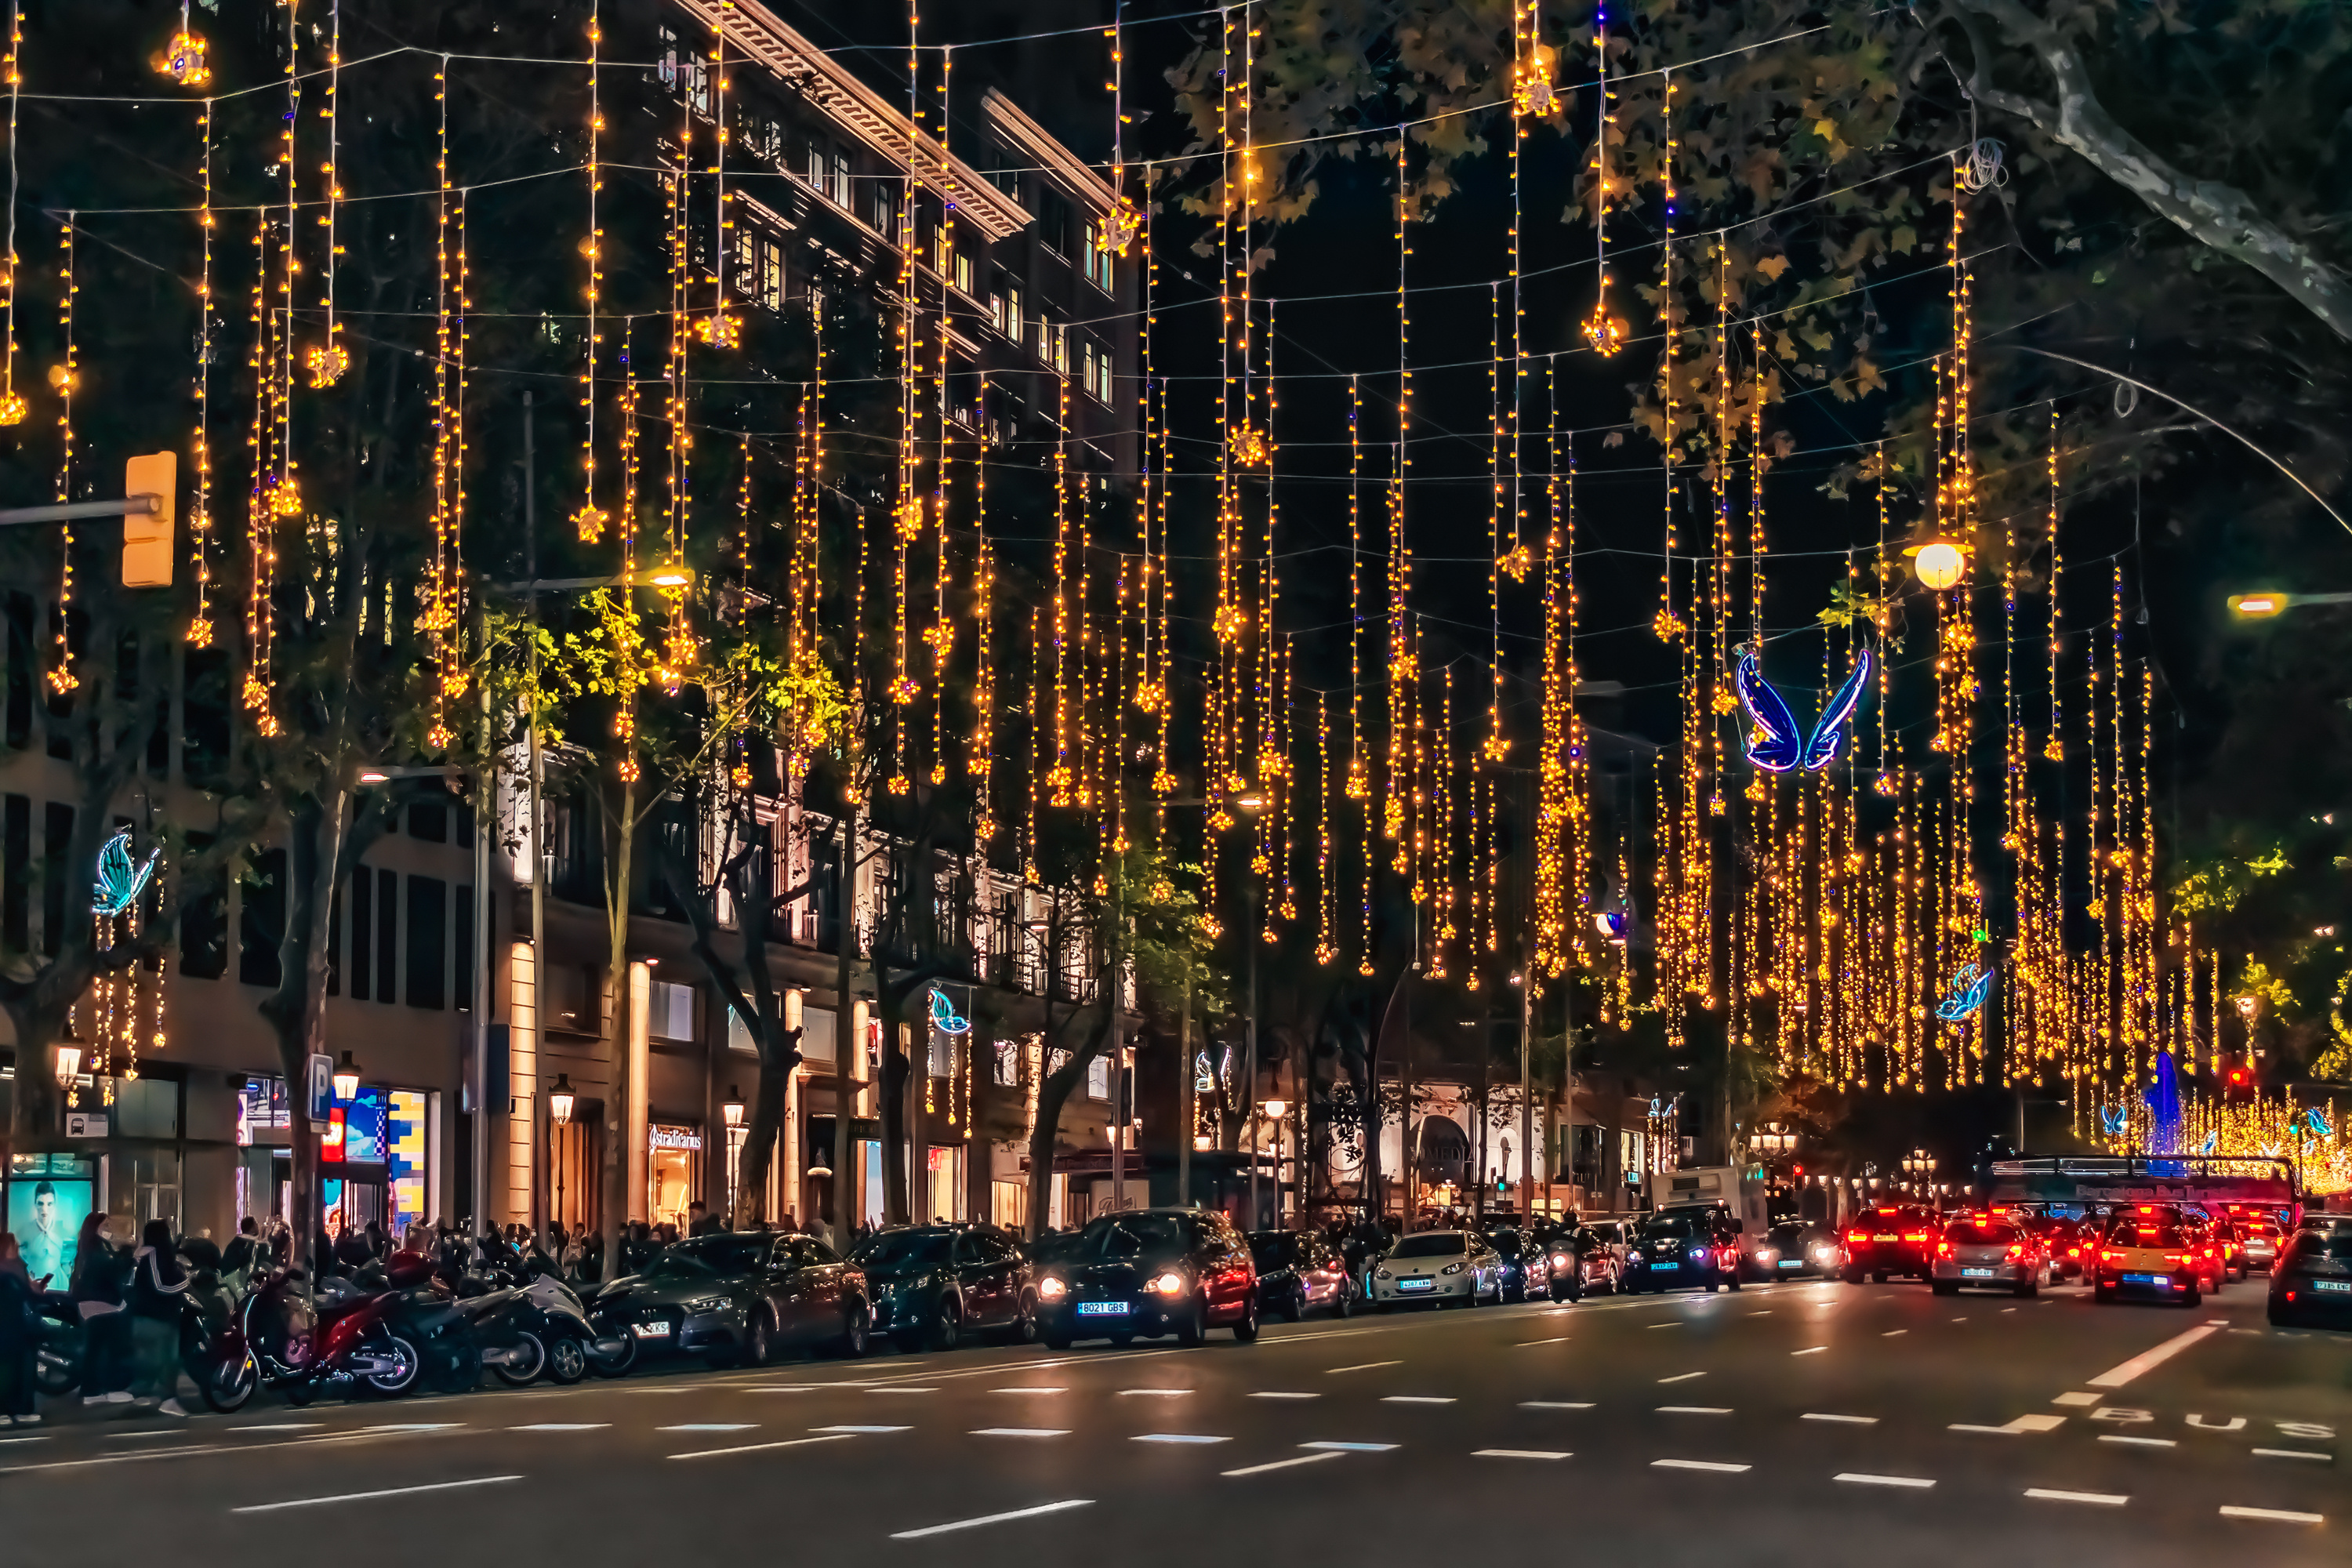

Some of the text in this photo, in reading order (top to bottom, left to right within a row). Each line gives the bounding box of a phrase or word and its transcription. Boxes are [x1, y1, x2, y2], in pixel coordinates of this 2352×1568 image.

[315, 1063, 328, 1112] P
[1083, 1303, 1124, 1312] 8021 GBS
[2089, 1407, 2336, 1438] BUS
